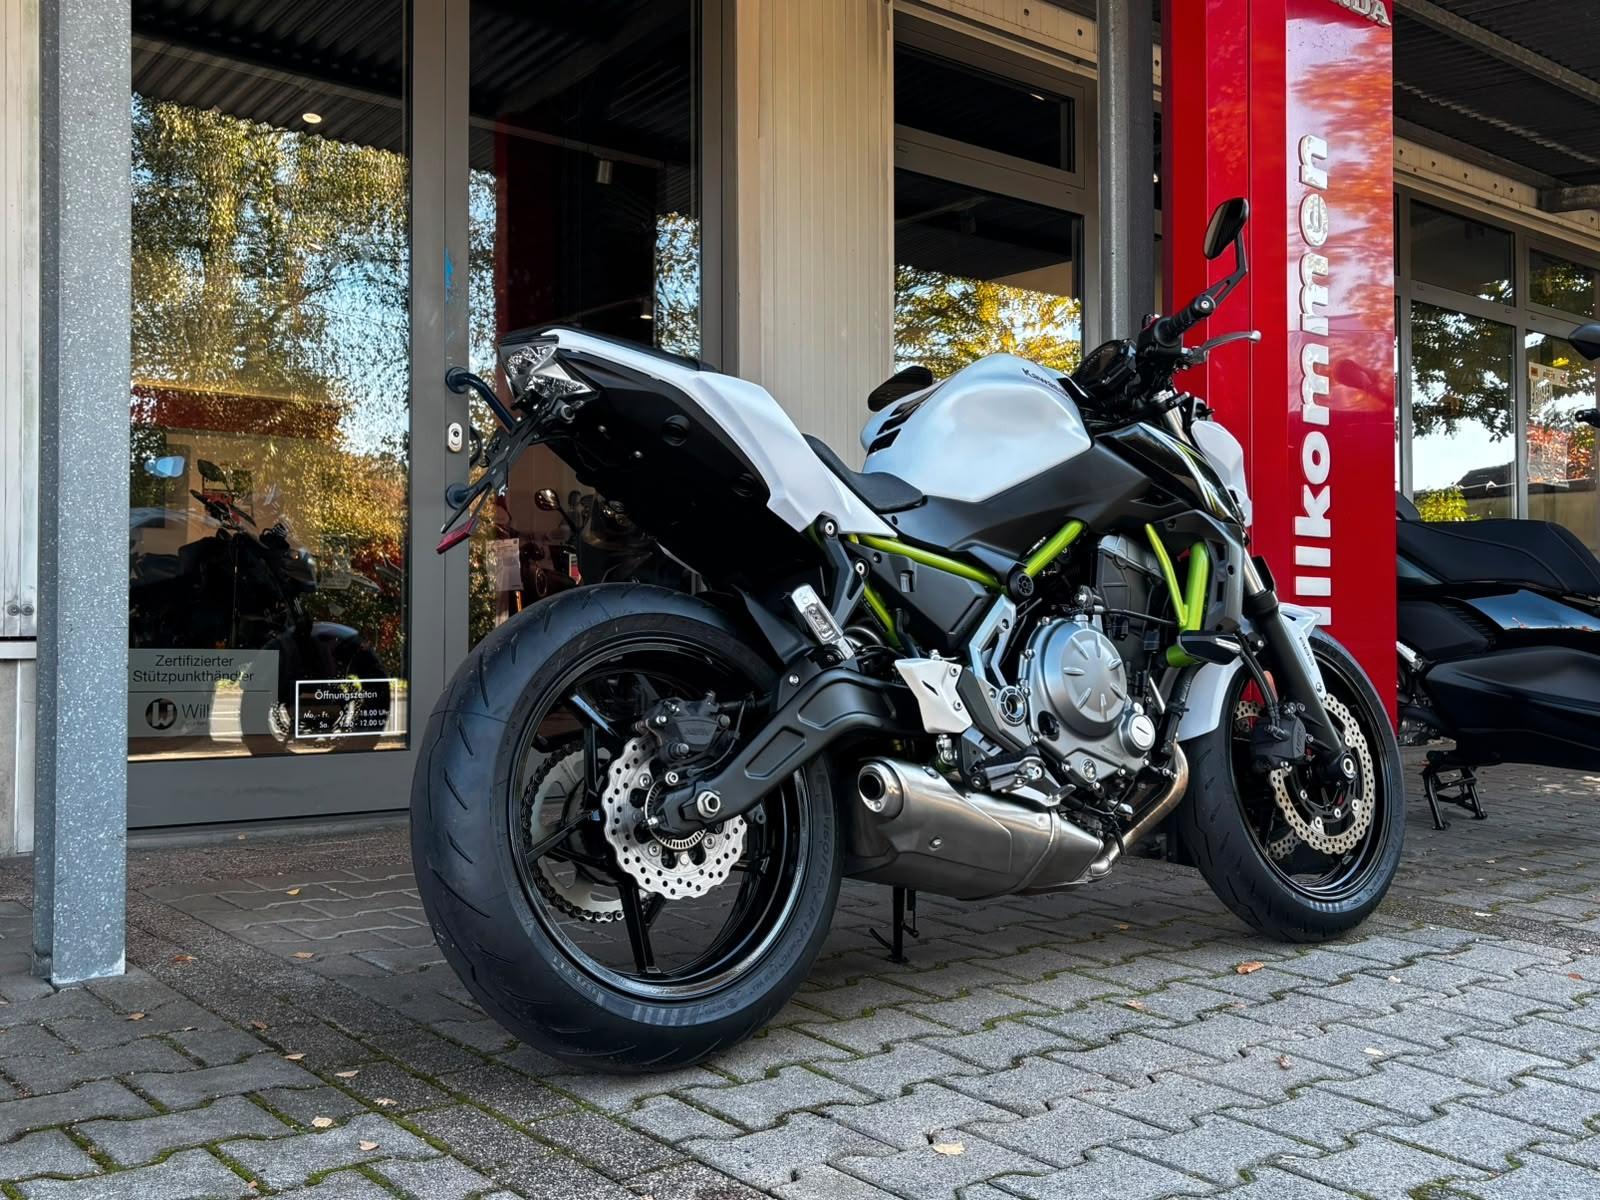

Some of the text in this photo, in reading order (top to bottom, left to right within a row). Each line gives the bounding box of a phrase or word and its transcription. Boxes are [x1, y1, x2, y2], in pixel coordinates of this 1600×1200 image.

[1295, 134, 1332, 626] llkommen
[155, 654, 234, 667] Zertifizierter
[314, 688, 378, 701] Öffnungszeiten
[360, 719, 377, 727] 12.00
